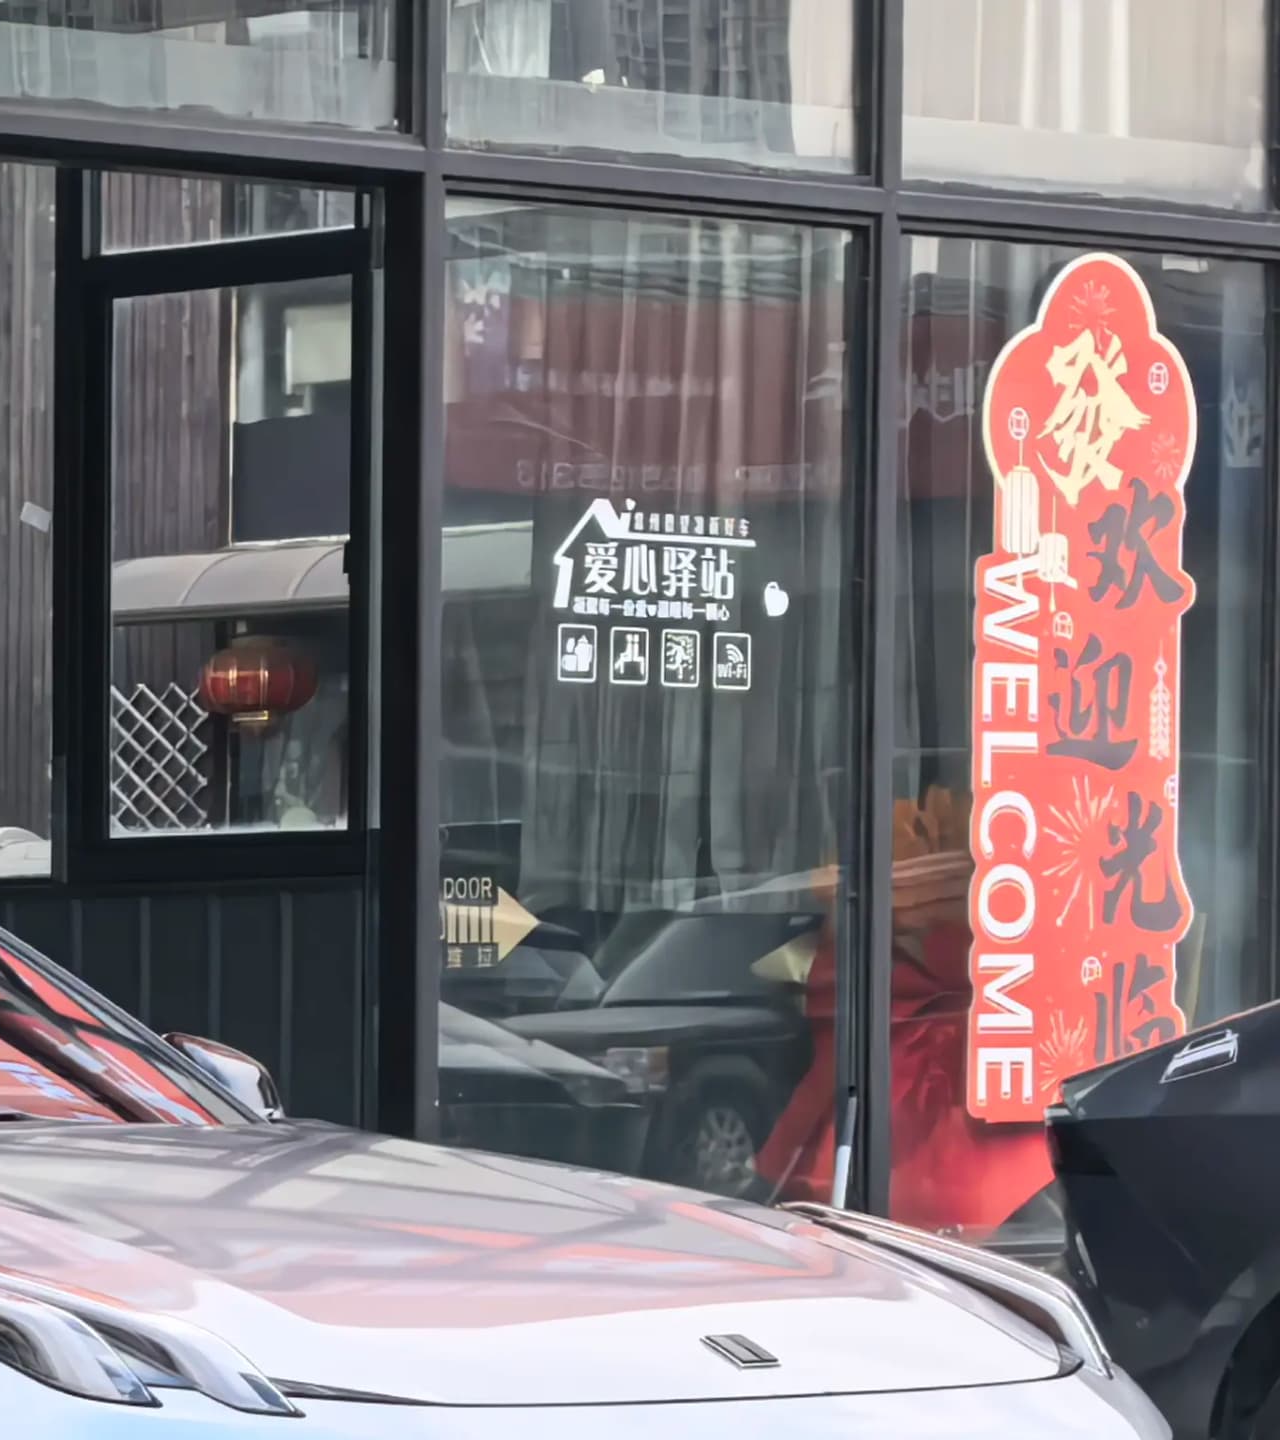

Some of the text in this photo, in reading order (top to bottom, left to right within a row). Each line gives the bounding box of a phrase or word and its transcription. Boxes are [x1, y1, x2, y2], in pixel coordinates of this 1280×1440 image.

[583, 542, 736, 600] 爱心驿站
[717, 663, 748, 680] Wi-Fi
[1046, 477, 1185, 1064] 欢迎光临
[976, 551, 1040, 1106] WELCOME
[443, 876, 493, 900] DOOR
